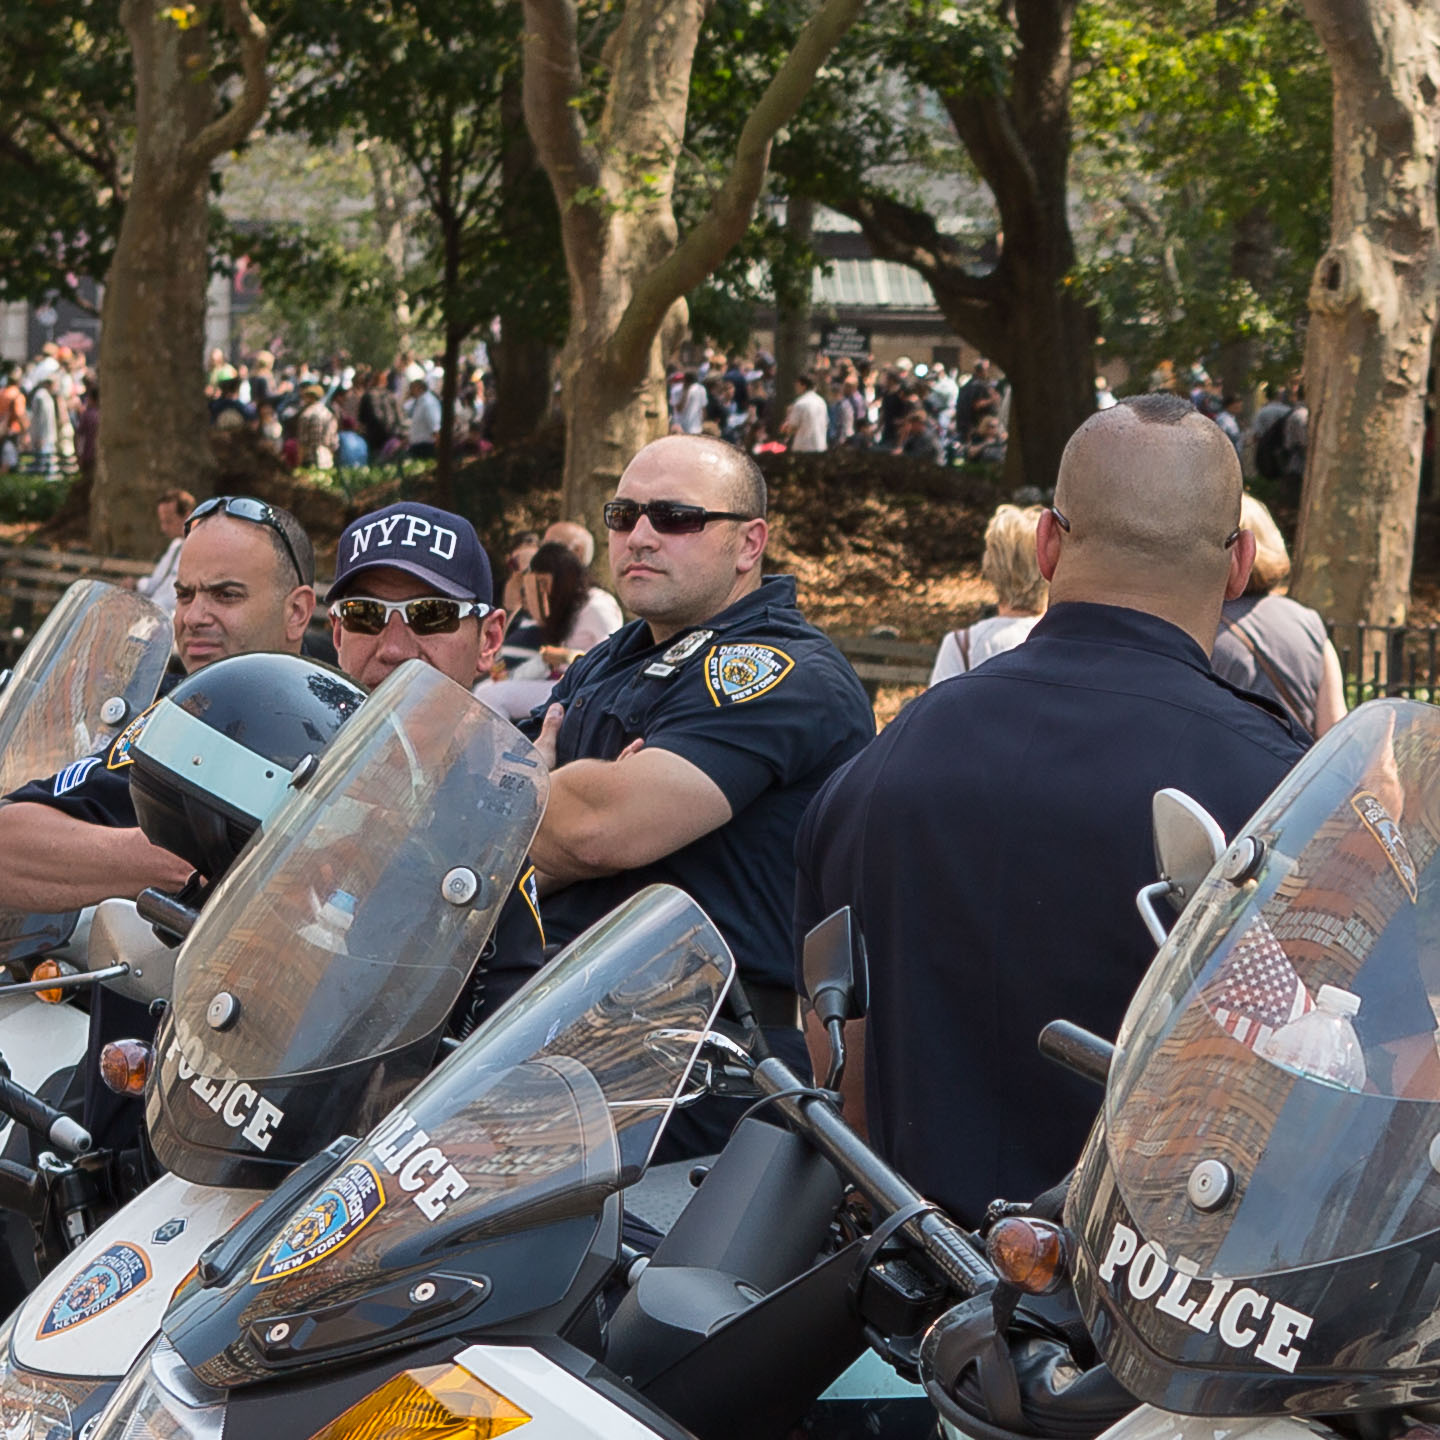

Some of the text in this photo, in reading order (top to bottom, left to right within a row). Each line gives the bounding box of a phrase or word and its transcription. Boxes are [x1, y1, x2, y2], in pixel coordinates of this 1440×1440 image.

[350, 514, 457, 562] NYPD
[166, 1018, 284, 1152] POLICE
[346, 1165, 376, 1198] POLICE
[369, 1109, 470, 1221] OLICE
[116, 1248, 142, 1274] POLICE
[273, 1232, 346, 1274] NEW YORK
[55, 1295, 117, 1330] NEW YORK
[1099, 1222, 1314, 1374] POLICE
